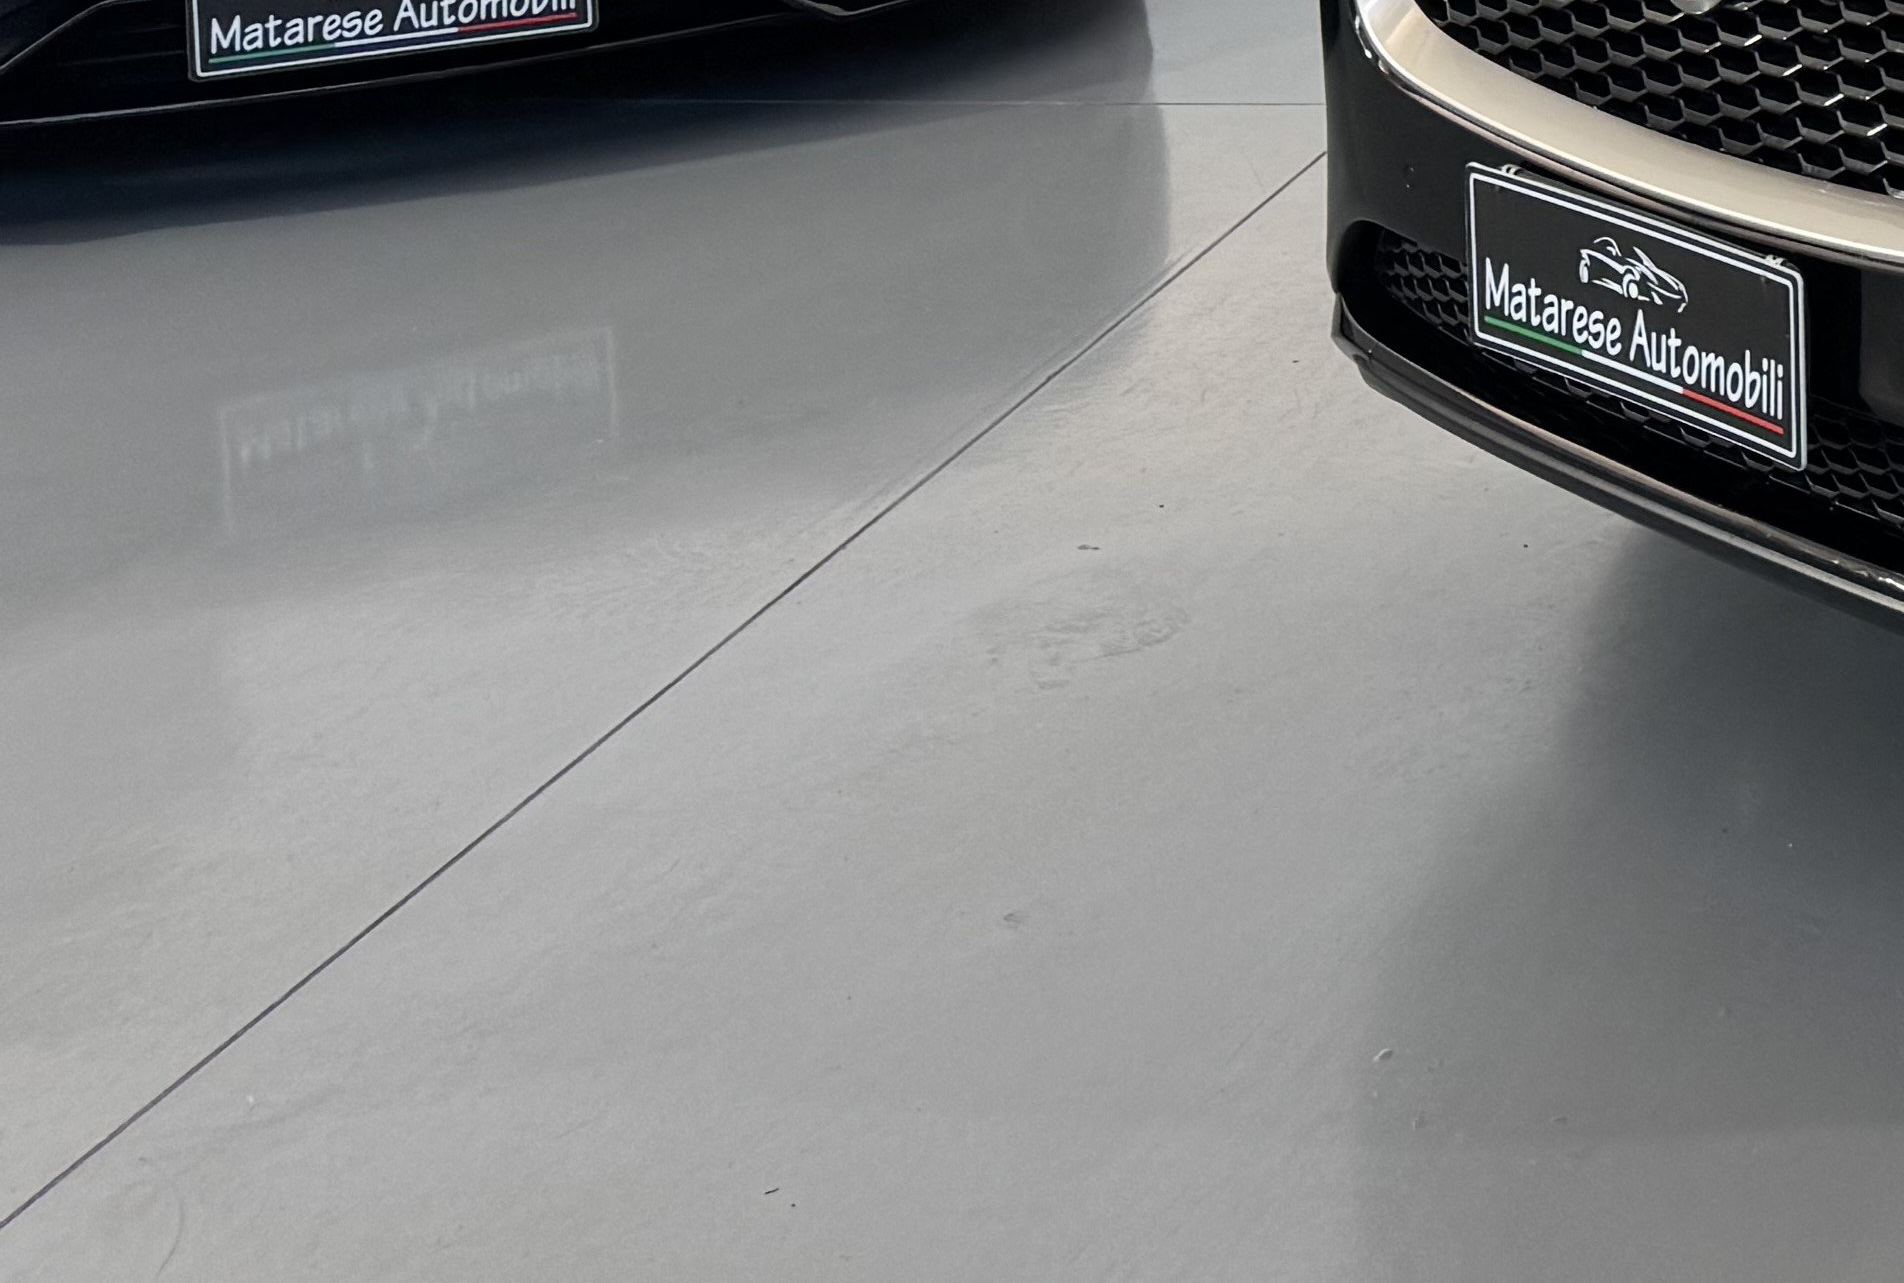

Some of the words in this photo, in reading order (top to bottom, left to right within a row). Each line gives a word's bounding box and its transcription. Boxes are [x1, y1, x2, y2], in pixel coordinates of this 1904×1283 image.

[210, 8, 384, 54] Matarese
[1484, 257, 1622, 356] Matarese
[1629, 309, 1785, 421] Automobili
